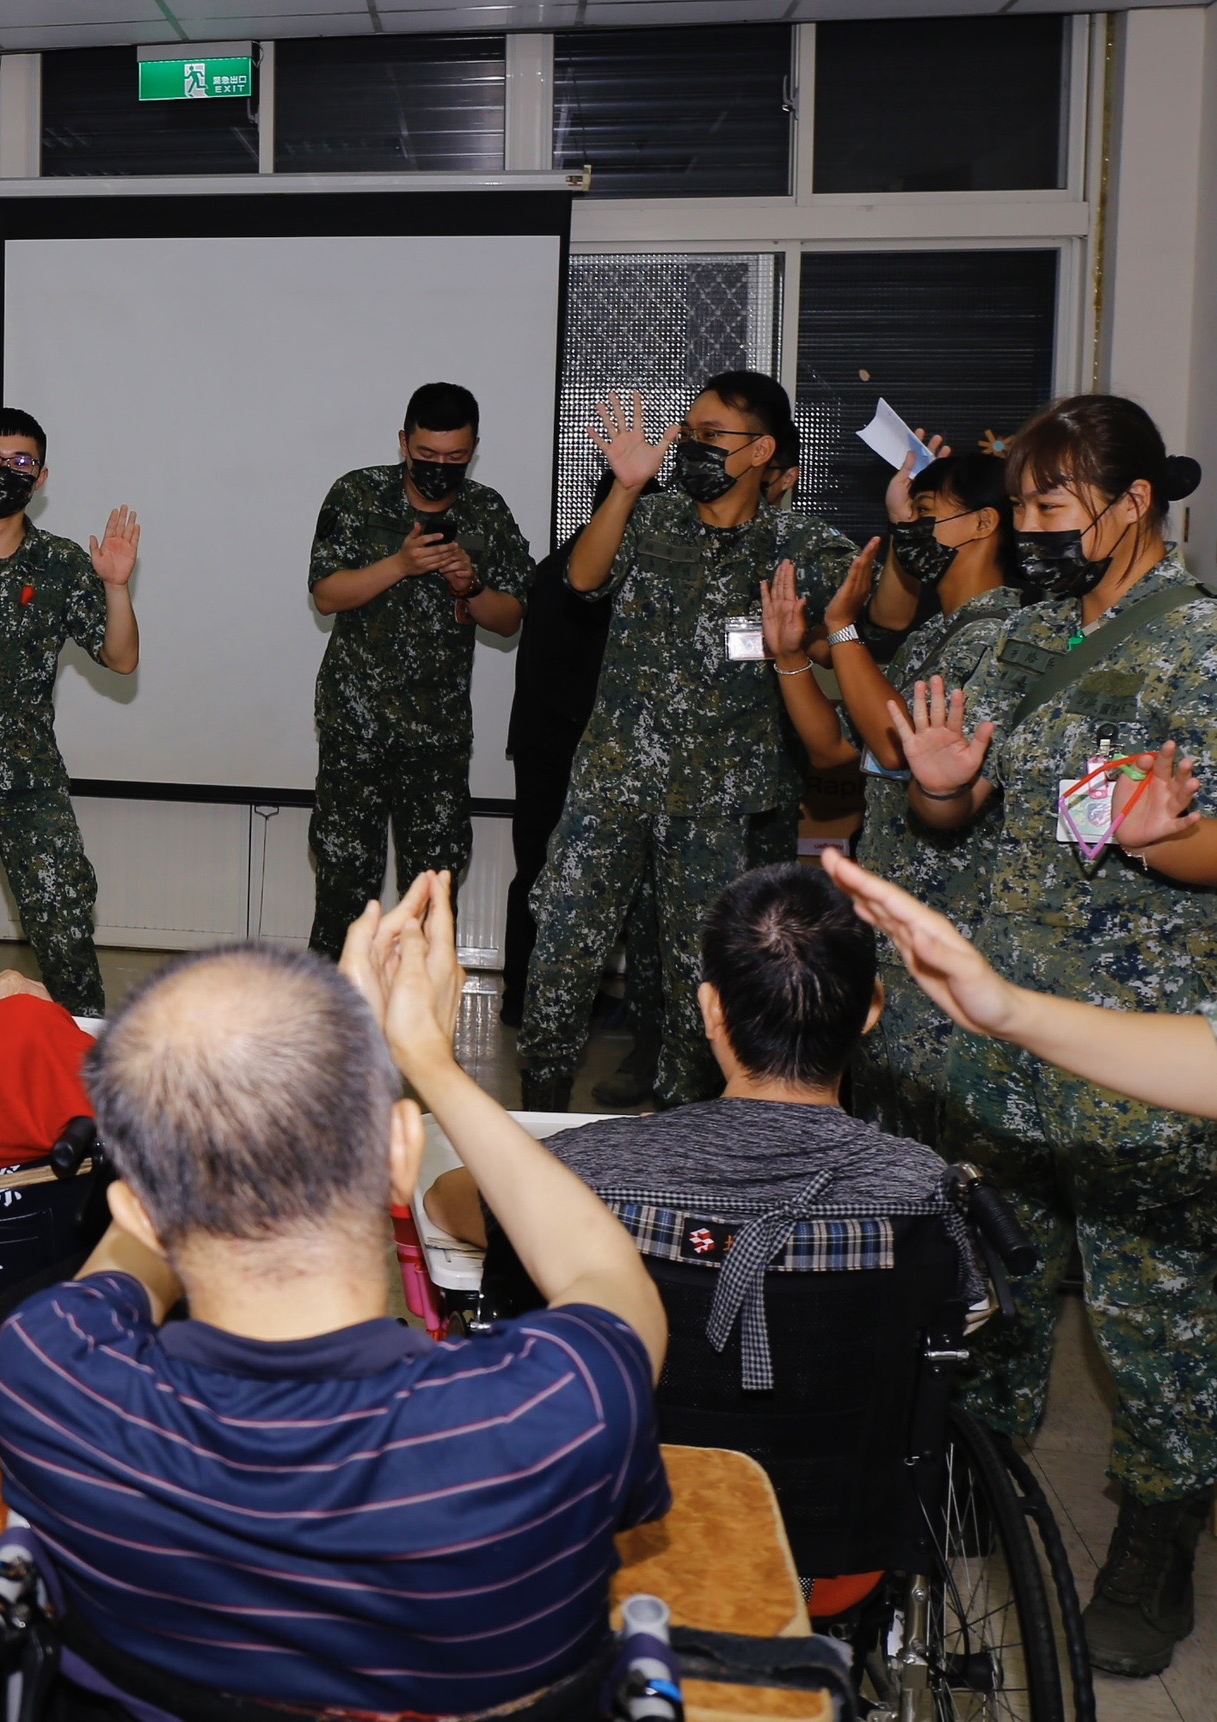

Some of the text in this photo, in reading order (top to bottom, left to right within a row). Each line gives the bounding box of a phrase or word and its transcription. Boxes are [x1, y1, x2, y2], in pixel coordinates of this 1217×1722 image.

[213, 75, 247, 85] 緊急出口
[215, 85, 245, 93] EXIT
